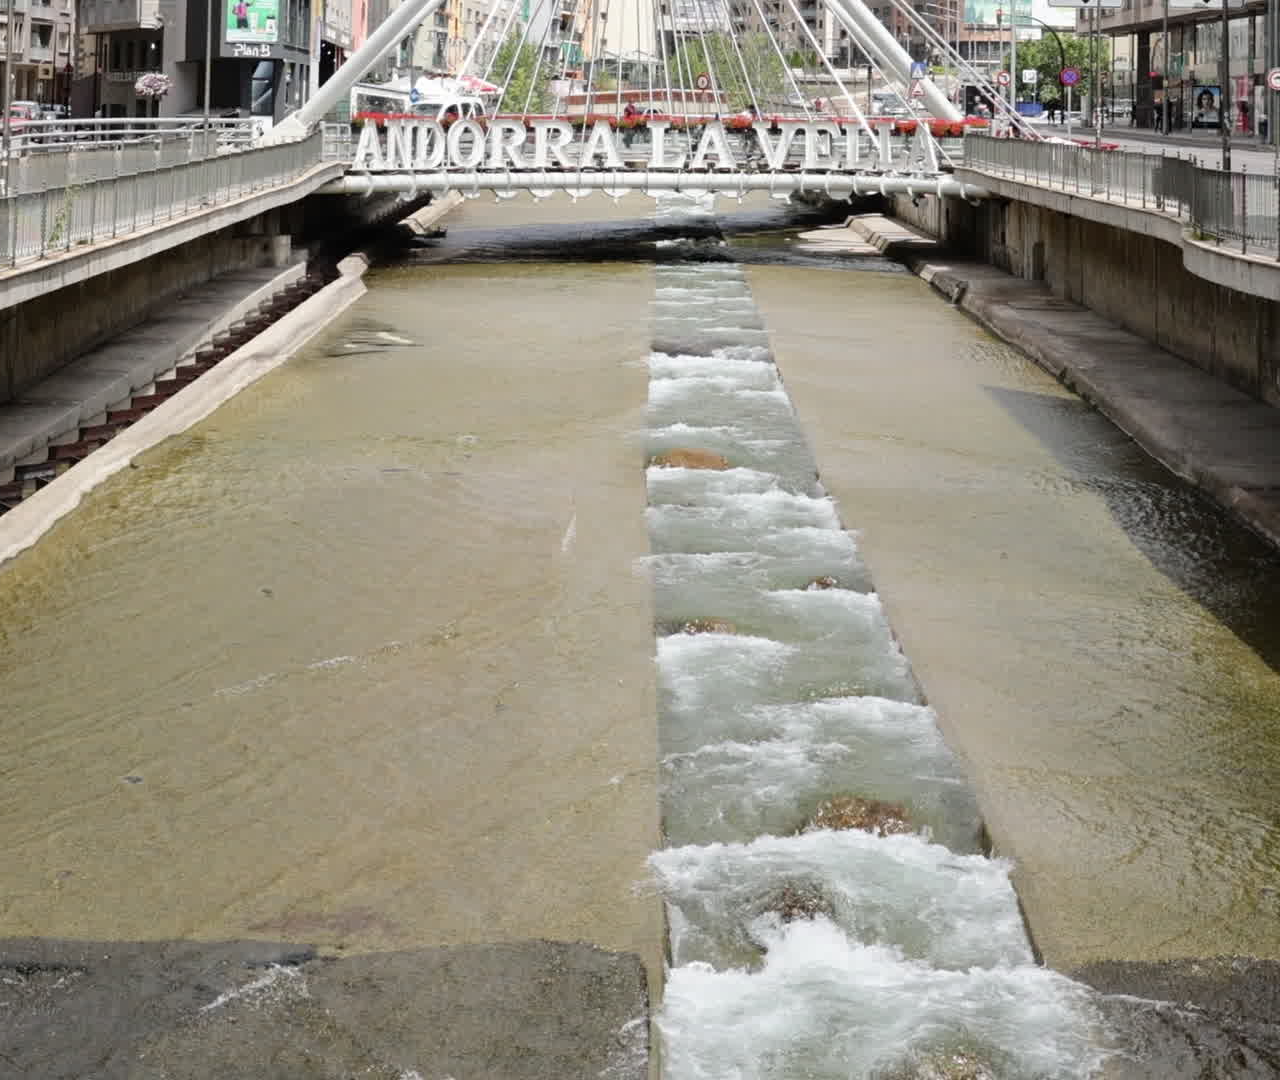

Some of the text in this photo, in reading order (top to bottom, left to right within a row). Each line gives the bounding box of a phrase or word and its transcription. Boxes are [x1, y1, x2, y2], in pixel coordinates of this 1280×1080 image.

[352, 118, 939, 170] ANDORRA LA VELLA
